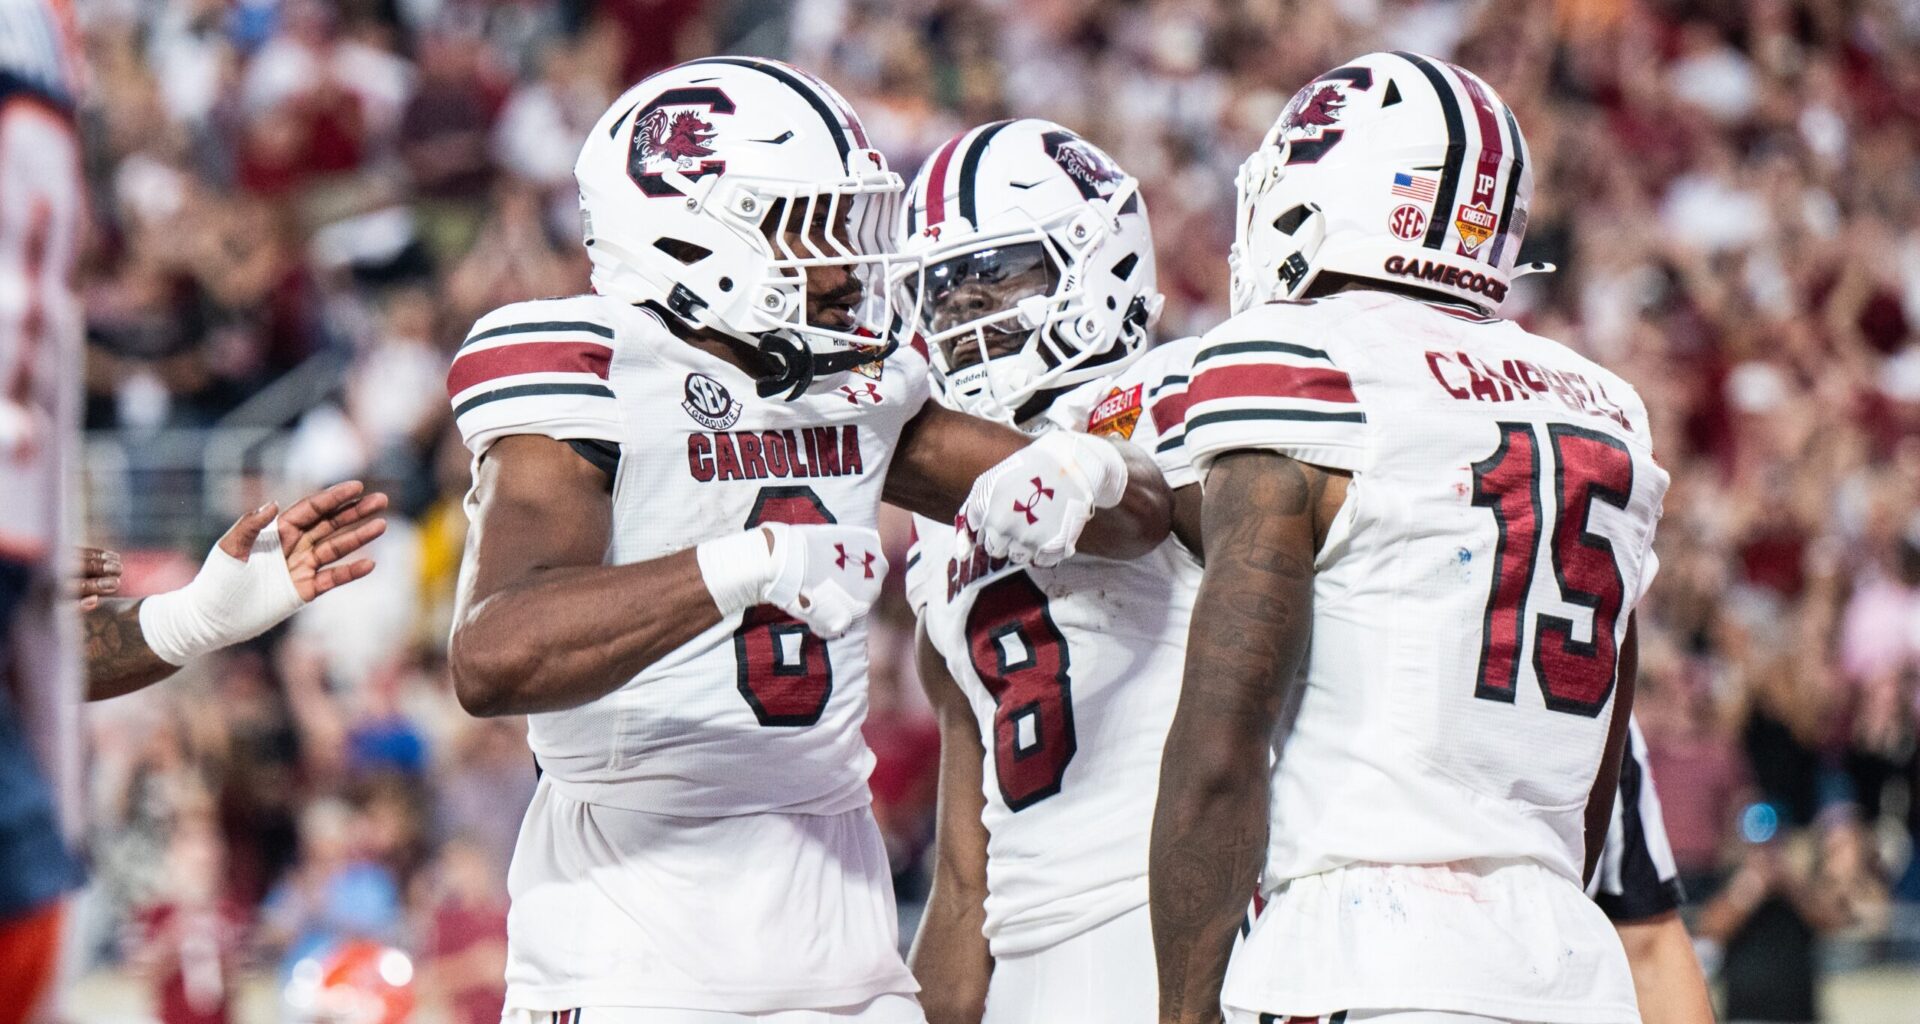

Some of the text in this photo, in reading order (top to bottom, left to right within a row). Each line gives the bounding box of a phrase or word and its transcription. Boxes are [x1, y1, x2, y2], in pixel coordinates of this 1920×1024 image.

[1477, 174, 1495, 195] IP
[1391, 205, 1424, 239] SEC
[688, 374, 728, 415] SEC
[1425, 350, 1634, 432] CAMPBELL
[691, 409, 737, 429] GRADUATE
[688, 424, 863, 482] CAROLINA
[1471, 421, 1634, 718] 15
[965, 568, 1077, 813] 8
